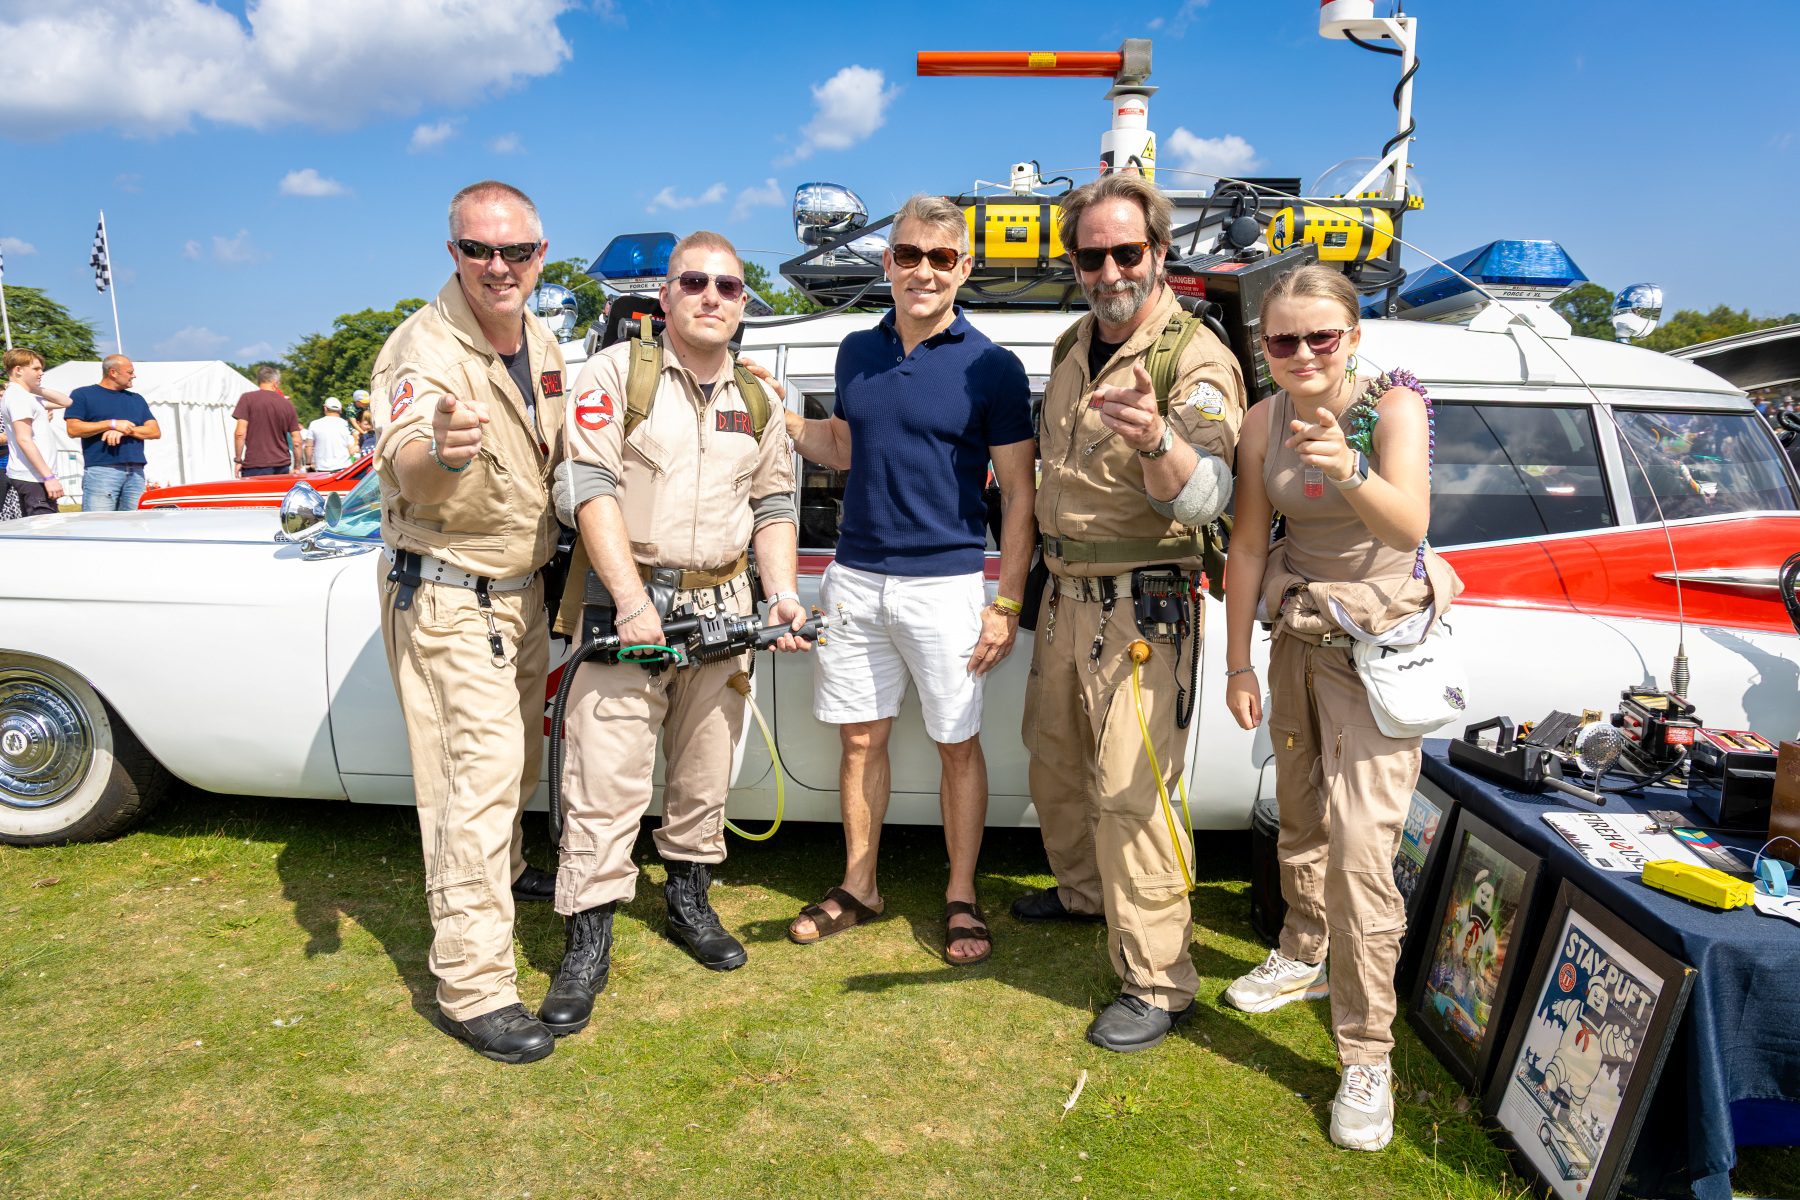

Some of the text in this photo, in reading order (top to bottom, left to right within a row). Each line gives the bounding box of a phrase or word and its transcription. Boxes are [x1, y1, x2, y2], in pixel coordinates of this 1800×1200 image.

[1169, 276, 1196, 285] DANGER
[718, 412, 729, 430] D.
[1565, 932, 1607, 976] STAY
[1604, 964, 1652, 1020] PUFT
